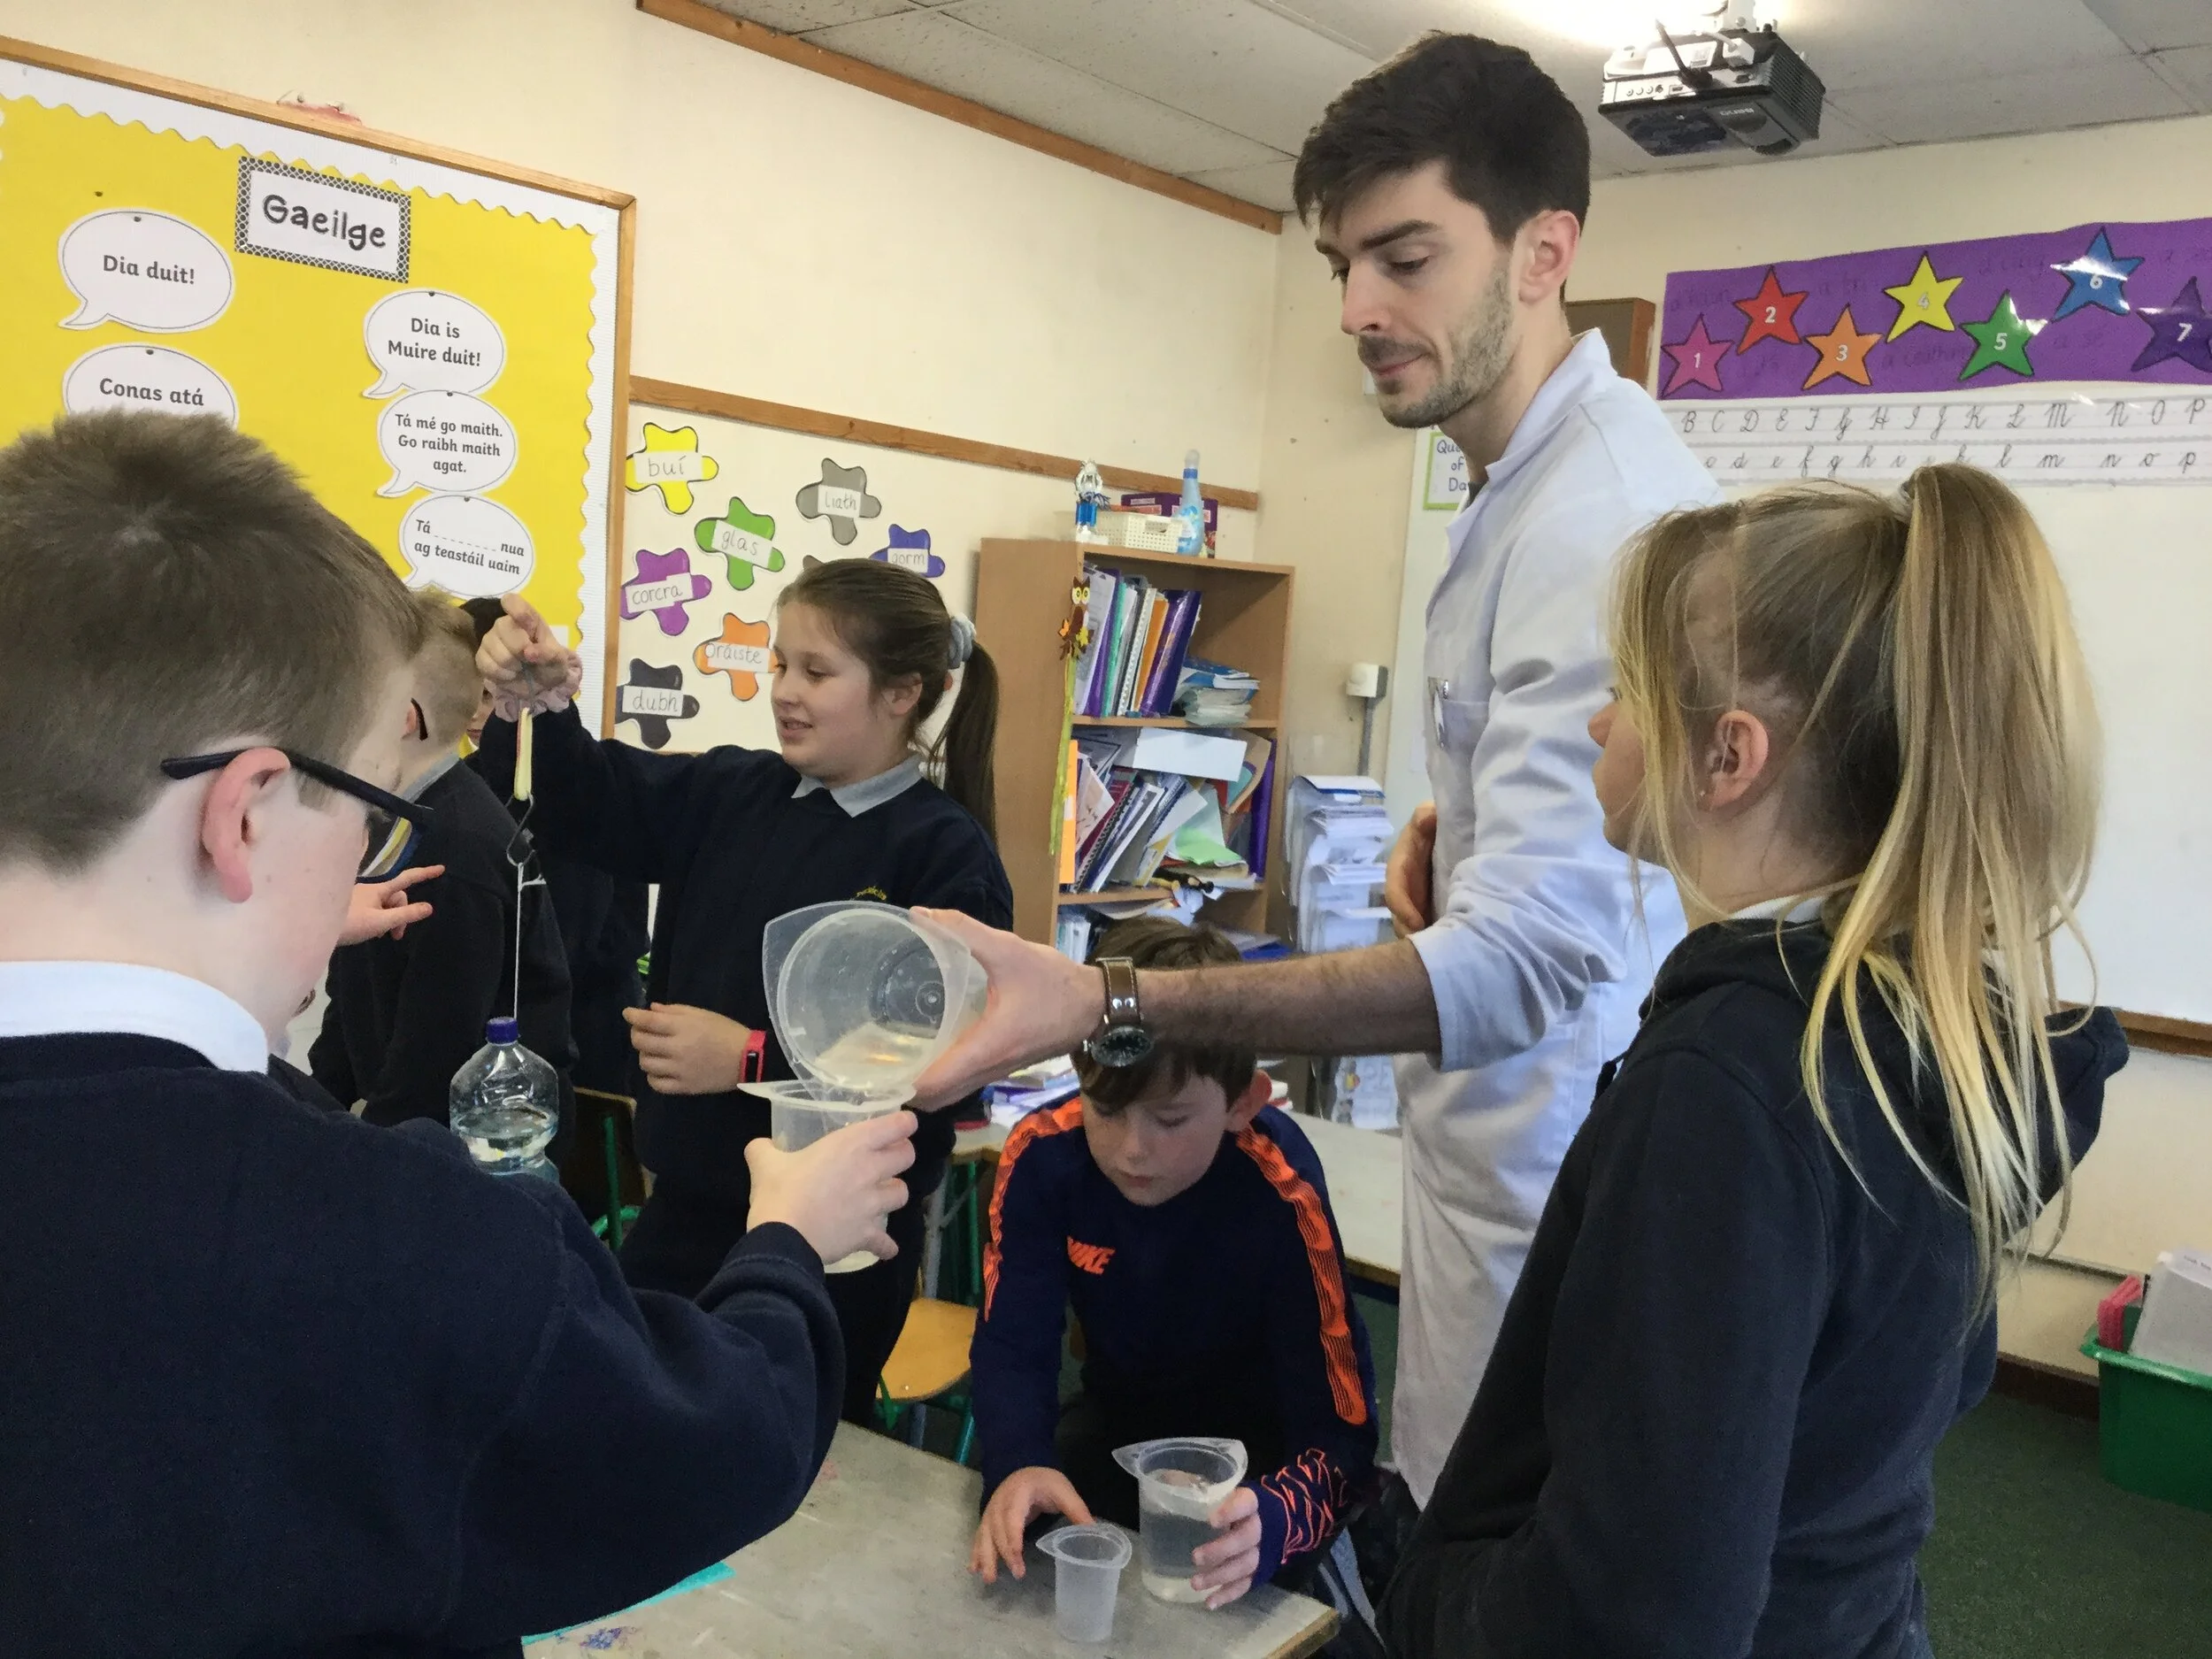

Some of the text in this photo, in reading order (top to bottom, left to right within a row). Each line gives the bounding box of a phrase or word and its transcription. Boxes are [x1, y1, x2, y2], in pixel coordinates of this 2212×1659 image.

[262, 193, 387, 251] Gaeilge
[103, 255, 196, 285] Dia duit!
[2090, 274, 2103, 289] 6
[1917, 291, 1930, 309] 4
[1765, 306, 1777, 323] 2
[411, 317, 460, 339] Dia is
[2178, 322, 2193, 342] 7
[1993, 333, 2008, 350] 5
[388, 340, 481, 367] Muire duit!
[1694, 352, 1701, 368] 1
[1836, 344, 1848, 361] 3
[98, 378, 204, 407] Conas atá
[395, 414, 503, 437] Tá mé go maith.
[1683, 411, 1697, 433] B
[1712, 410, 1725, 433] C
[1740, 410, 1759, 432] D
[1776, 408, 1789, 431] E
[2185, 398, 2206, 424] P
[398, 434, 501, 457] Go raibh maith
[433, 460, 467, 474] agat.
[648, 455, 687, 477] buí
[1451, 456, 1465, 471] of
[1448, 478, 1469, 492] Da
[416, 519, 431, 534] Tá
[501, 542, 525, 557] nua
[722, 530, 759, 556] glas
[414, 542, 520, 575] ag teastáil uaim
[632, 586, 683, 605] corcra
[632, 689, 679, 713] dubh
